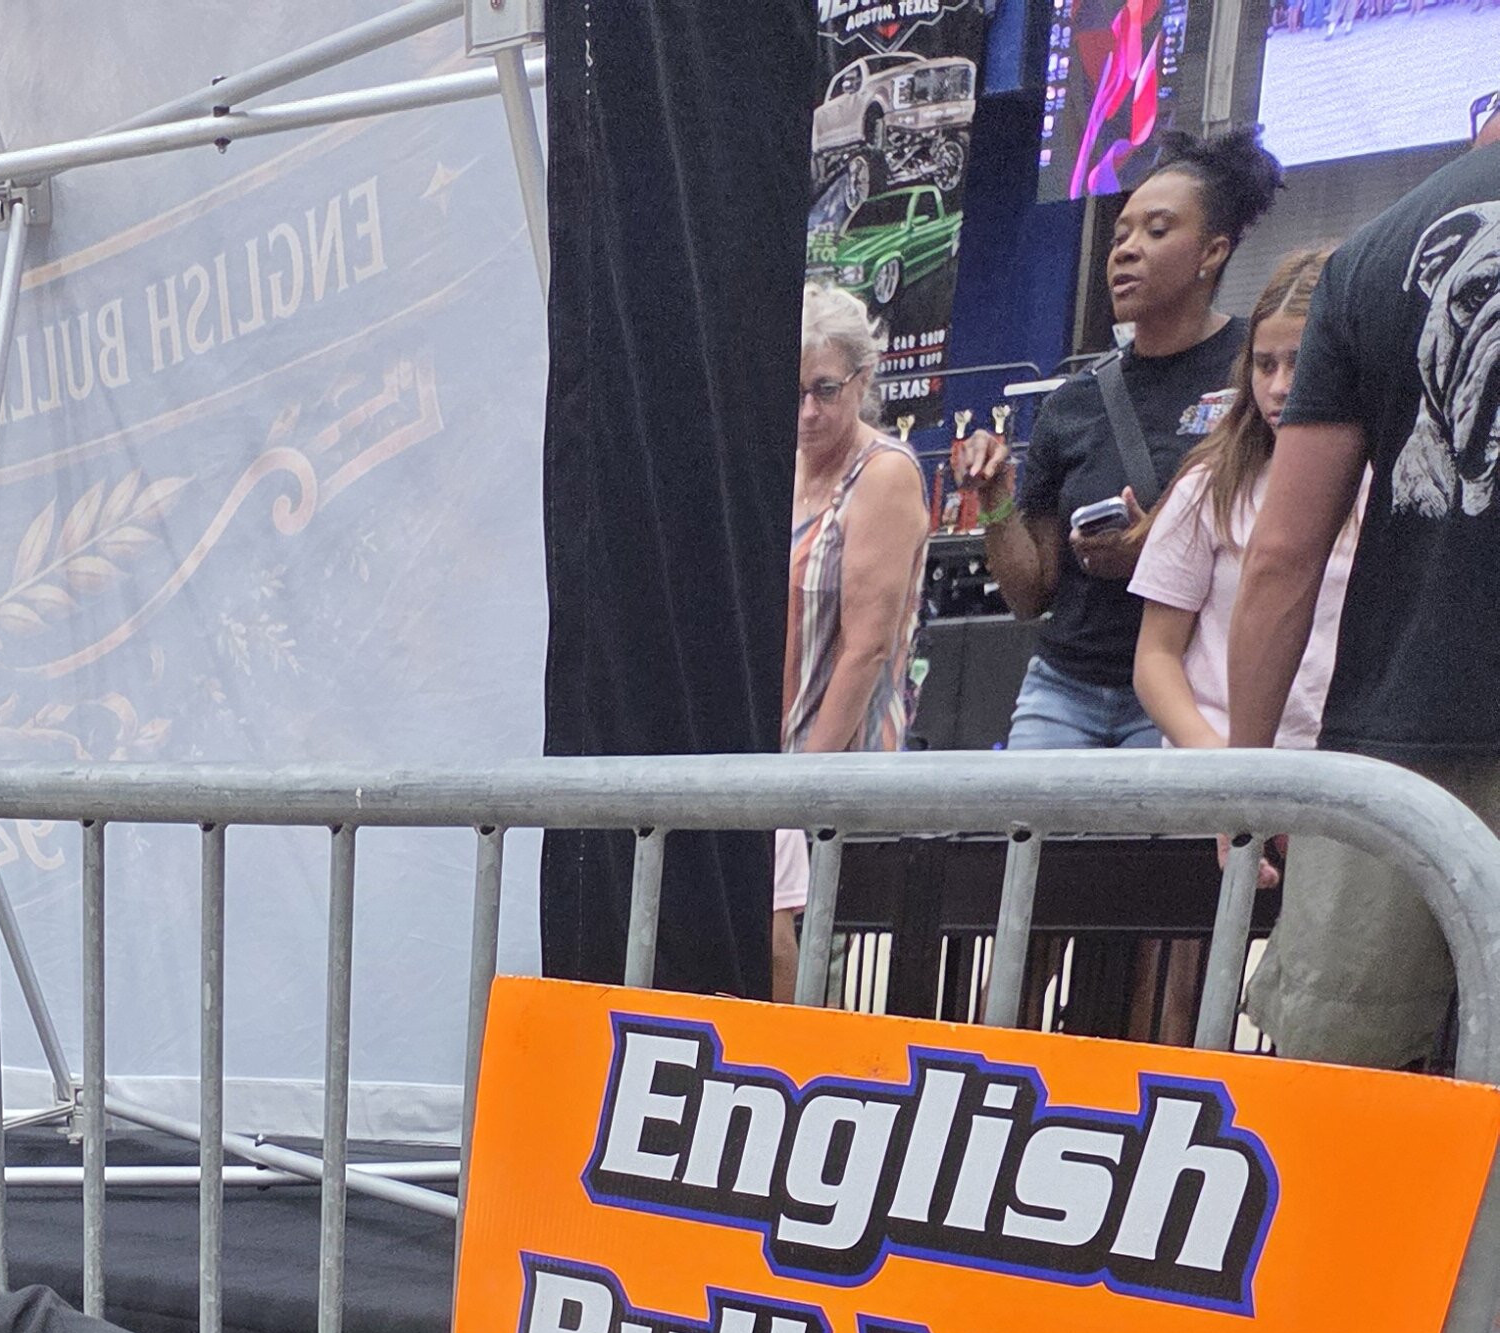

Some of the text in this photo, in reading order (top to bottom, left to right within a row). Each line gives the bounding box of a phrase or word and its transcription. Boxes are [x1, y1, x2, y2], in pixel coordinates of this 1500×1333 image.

[898, 0, 940, 17] TEXAS
[878, 378, 931, 401] TEXAS
[599, 1032, 1252, 1273] English
